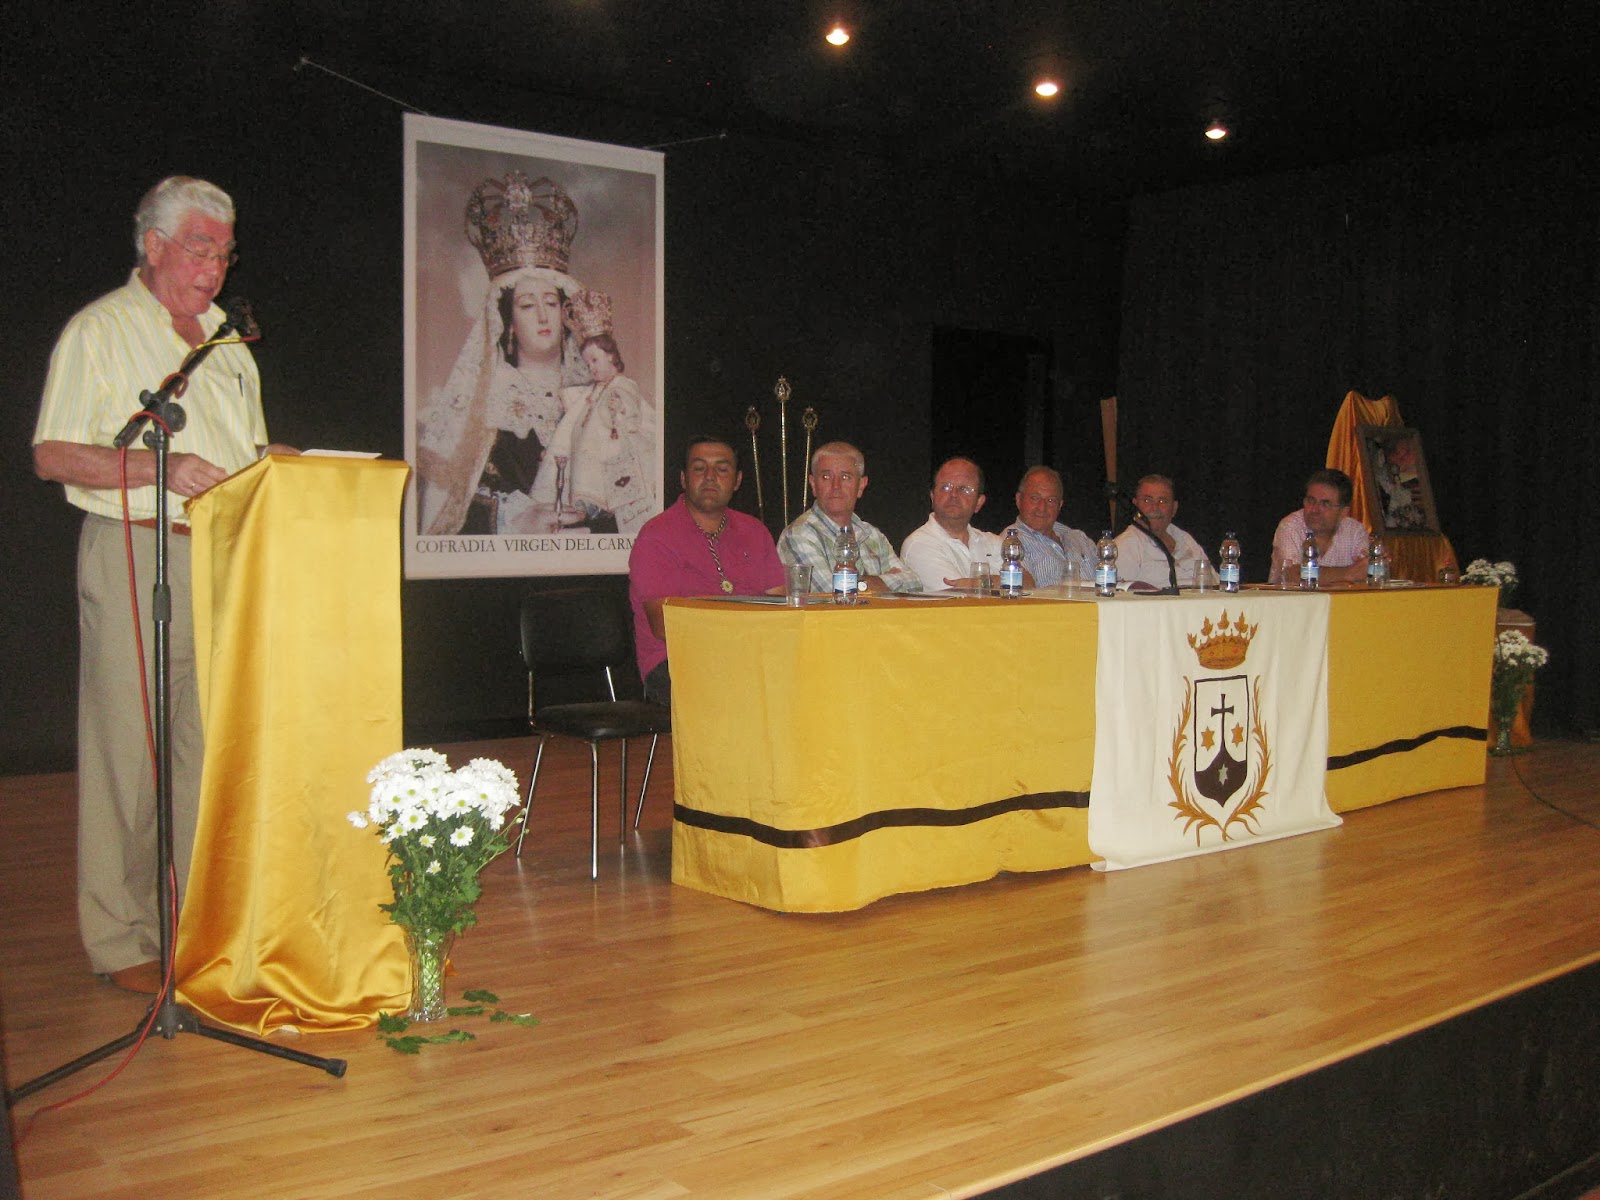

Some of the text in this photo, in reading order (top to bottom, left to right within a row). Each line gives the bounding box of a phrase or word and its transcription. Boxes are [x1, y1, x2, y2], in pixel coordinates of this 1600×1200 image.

[416, 539, 496, 554] COFRADIA
[504, 538, 561, 552] VIRGEN
[565, 537, 594, 551] DEL
